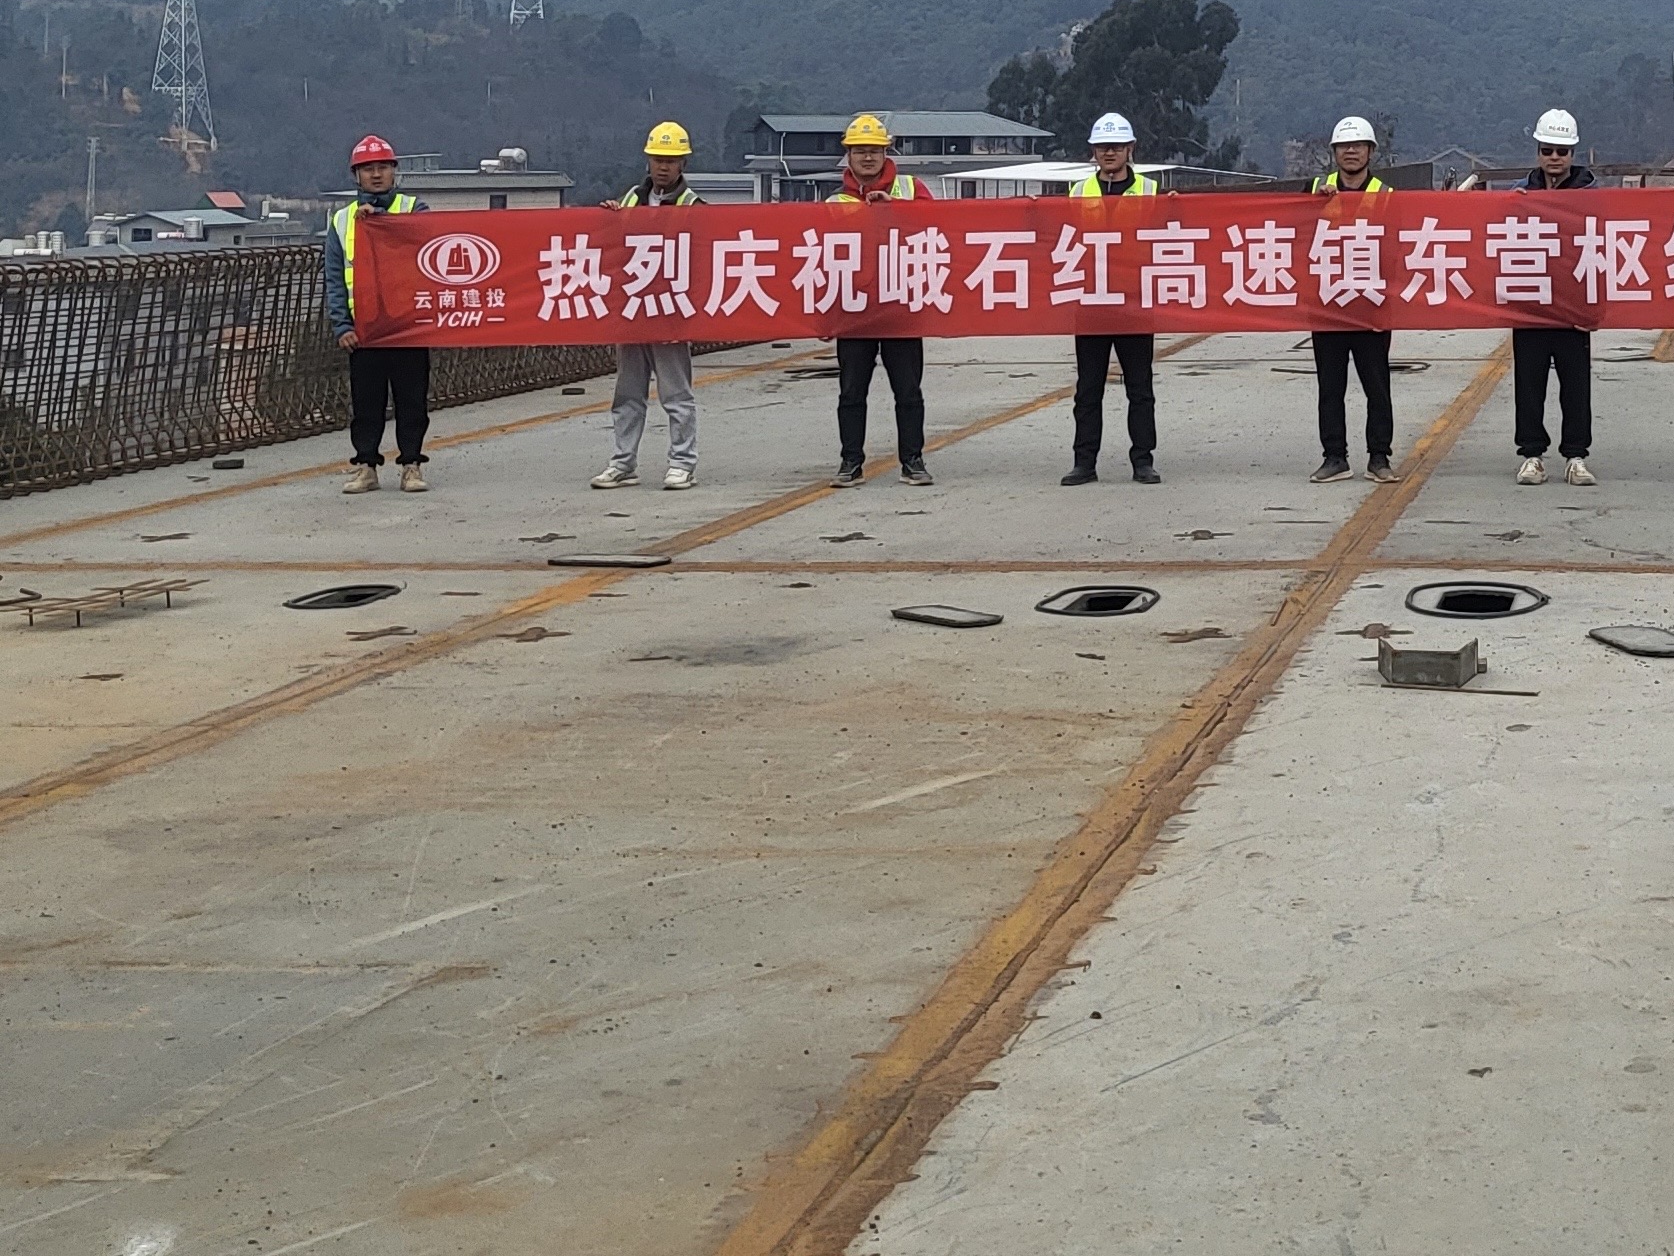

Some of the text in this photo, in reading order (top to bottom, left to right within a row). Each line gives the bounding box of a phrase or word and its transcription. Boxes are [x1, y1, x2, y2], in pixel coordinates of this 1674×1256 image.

[413, 288, 506, 309] 云南建投
[437, 310, 484, 328] YCIH
